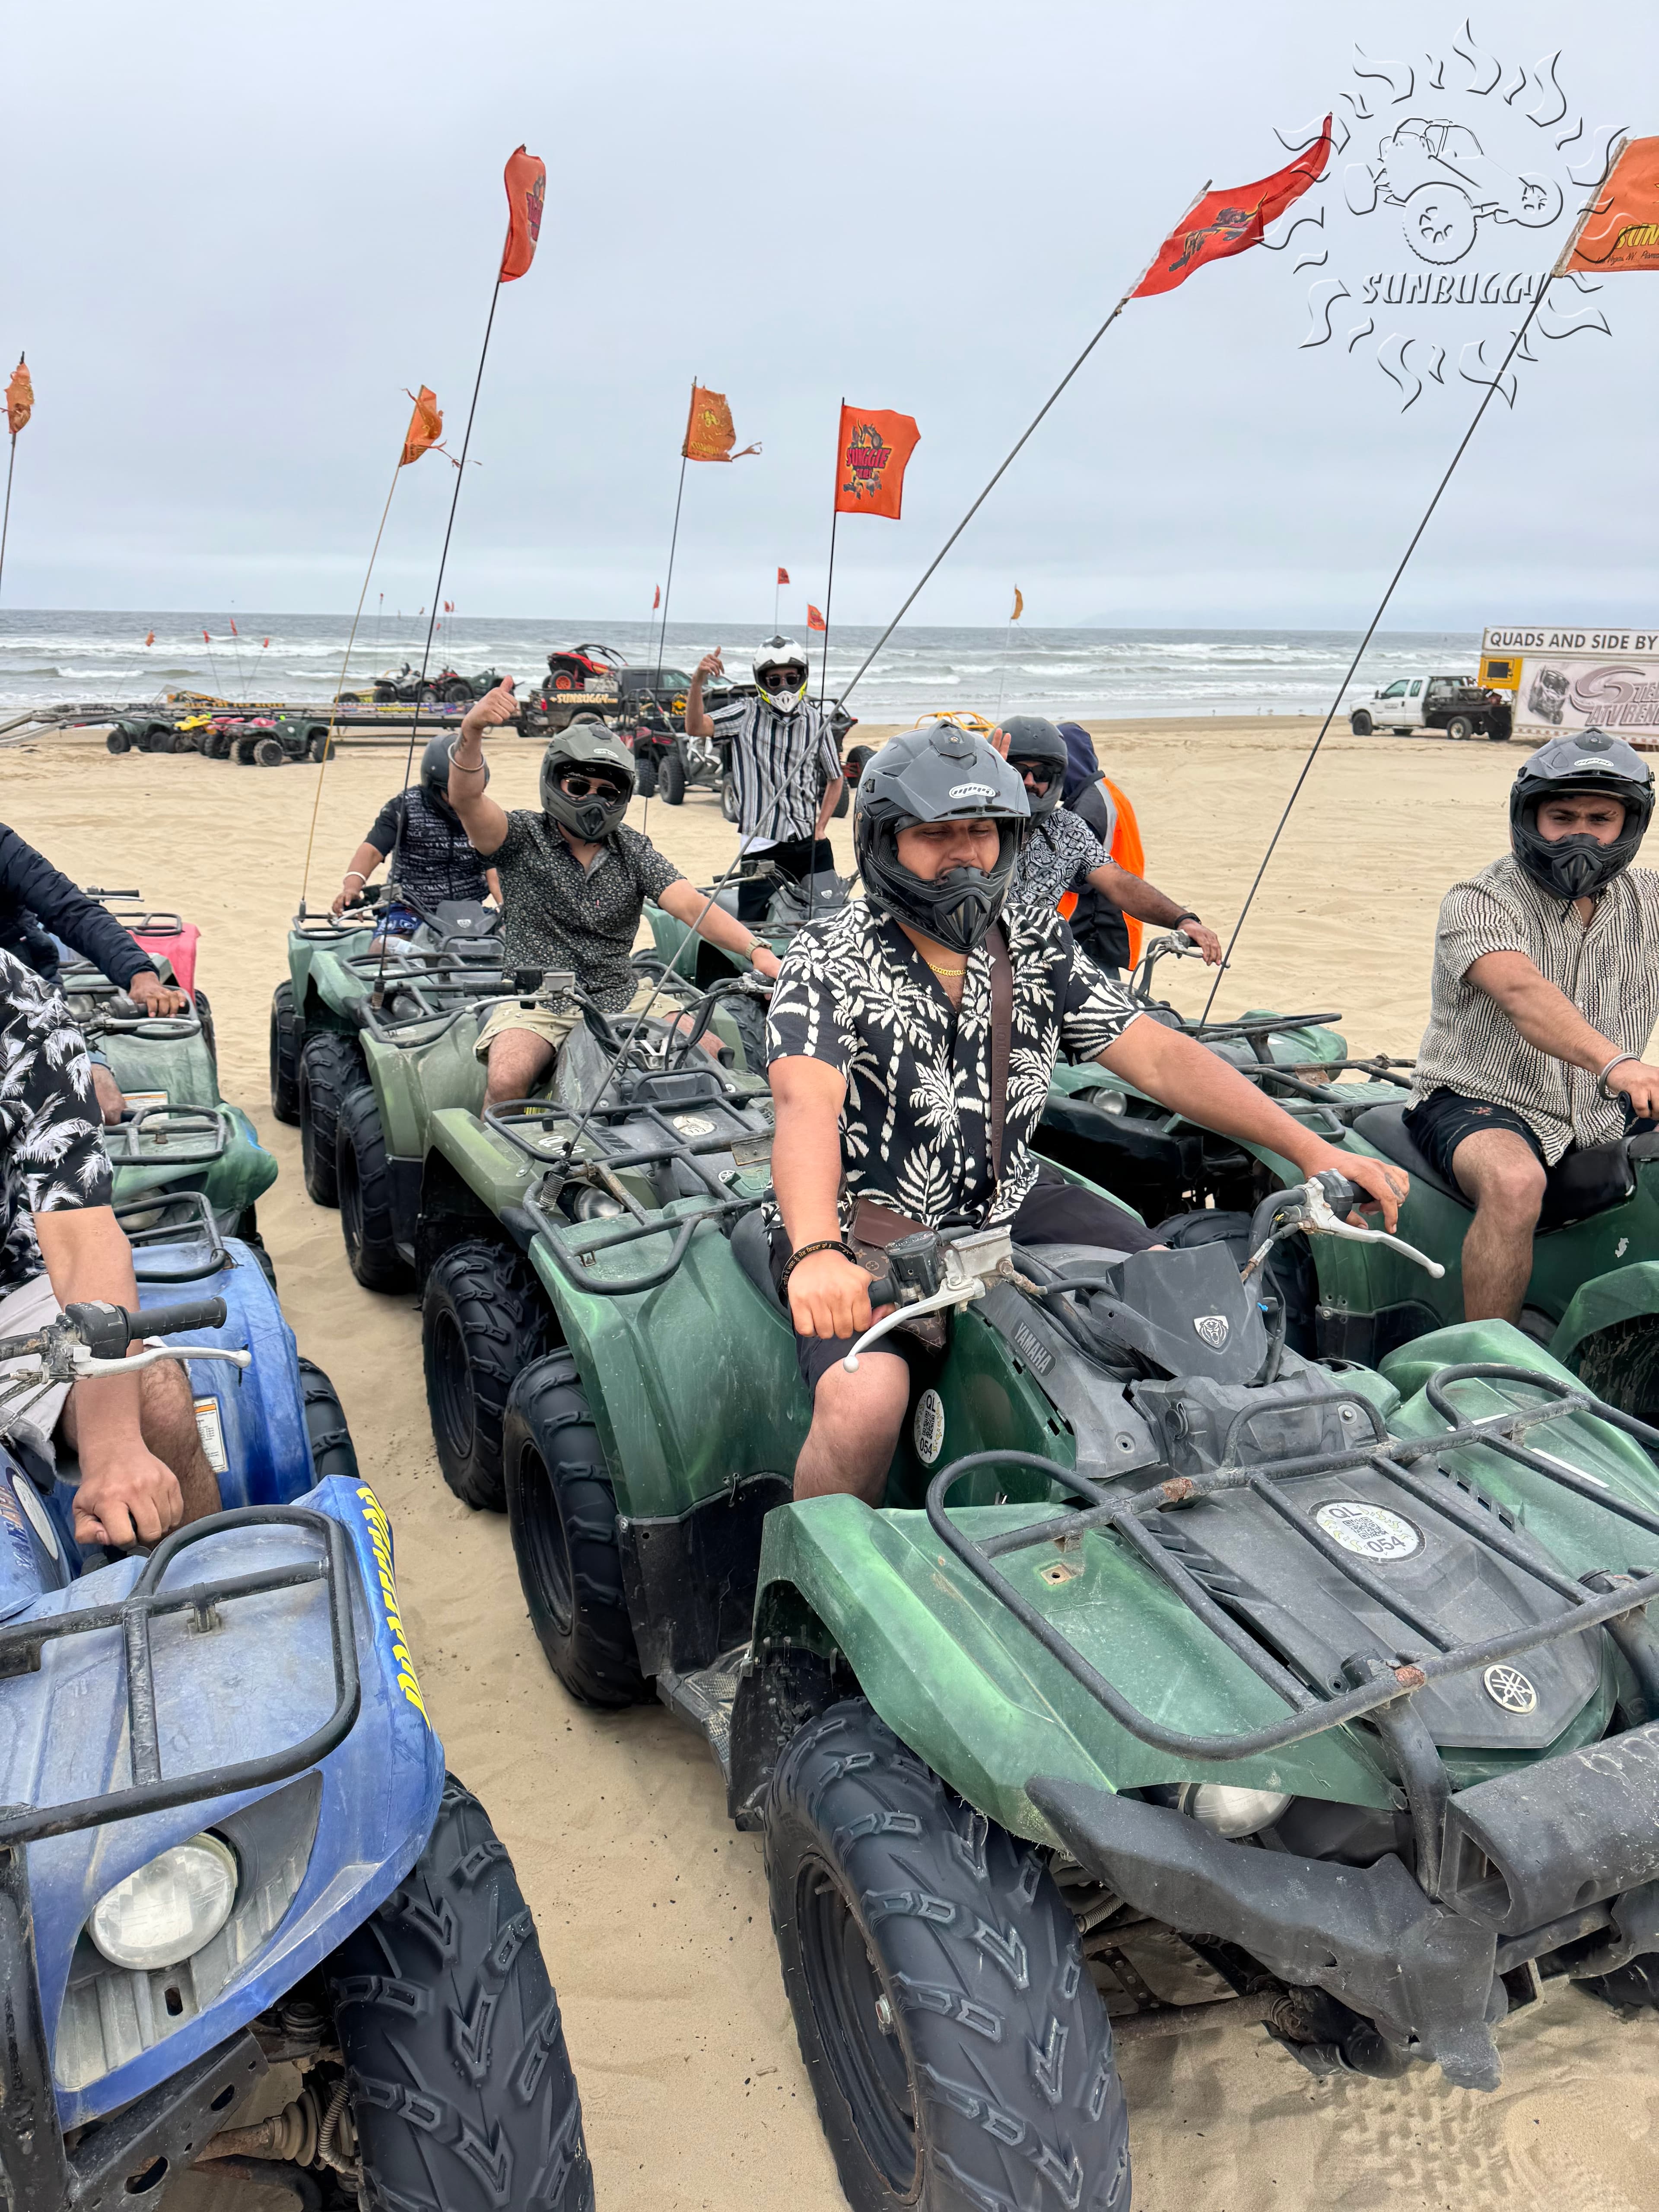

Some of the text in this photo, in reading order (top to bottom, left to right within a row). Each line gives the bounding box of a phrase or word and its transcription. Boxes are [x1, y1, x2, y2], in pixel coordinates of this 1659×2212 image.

[1615, 223, 1659, 249] SUN
[1491, 632, 1658, 649] QUADS AND SIDE BY
[1585, 704, 1624, 726] ATV
[1014, 1322, 1052, 1373] YAMAHA
[926, 1395, 936, 1413] QL
[920, 1437, 932, 1457] 054
[1328, 1507, 1362, 1519] QL
[1367, 1536, 1406, 1553] 054
